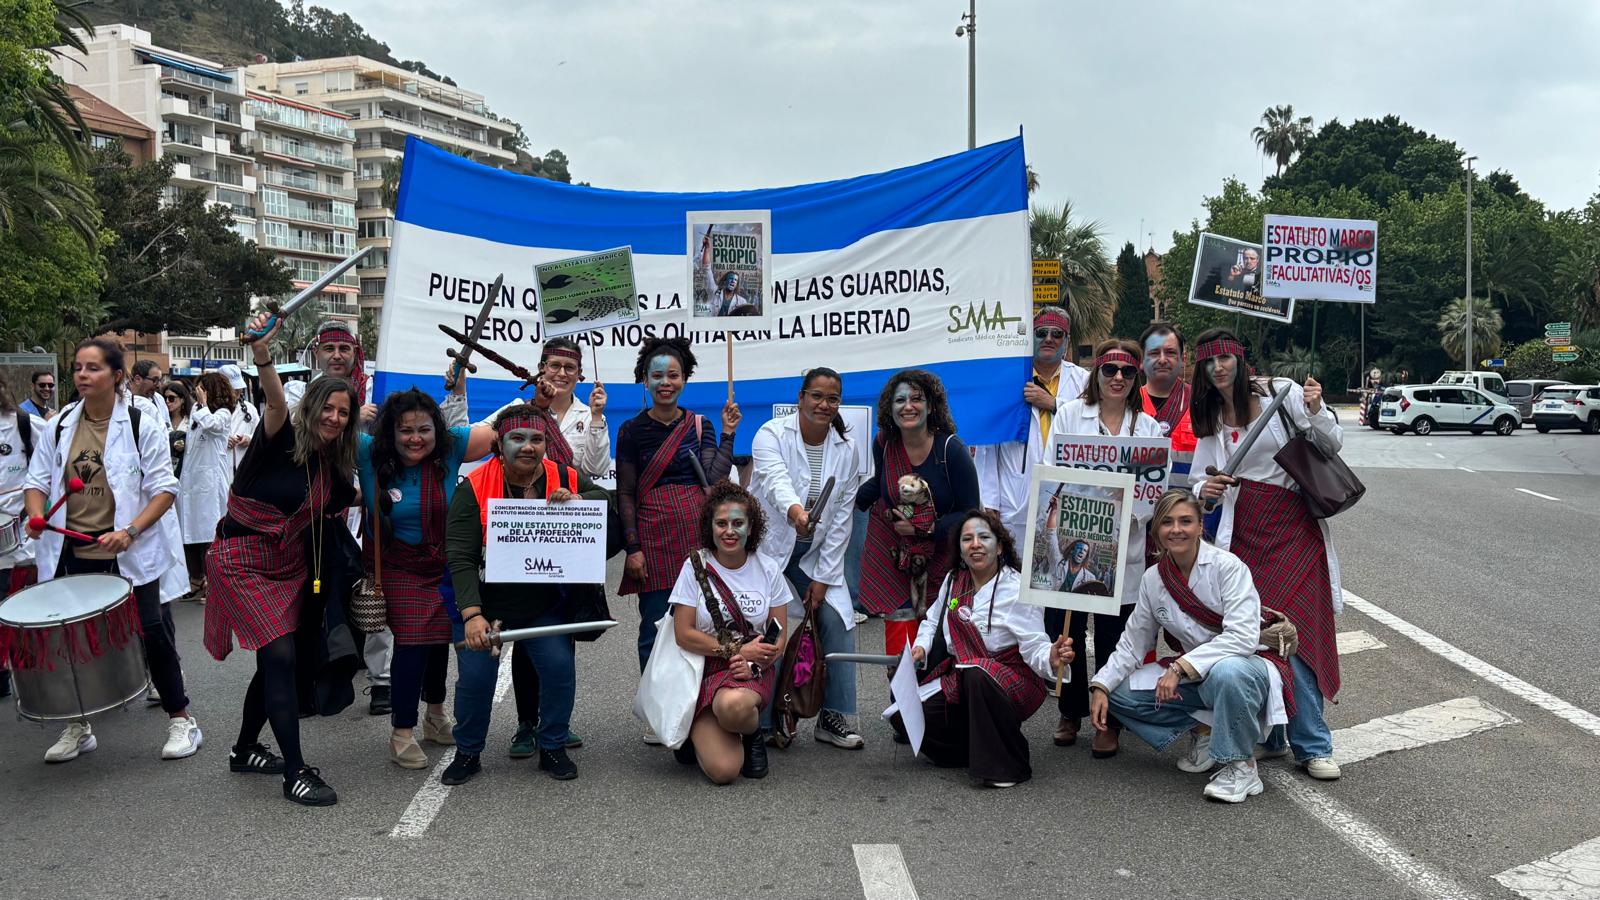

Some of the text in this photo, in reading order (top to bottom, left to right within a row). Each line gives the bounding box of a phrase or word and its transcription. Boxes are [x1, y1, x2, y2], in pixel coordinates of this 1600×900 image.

[712, 233, 757, 249] ESTATUTO
[1267, 225, 1373, 249] ESTATUTO MARCO
[712, 248, 757, 264] PROPIO
[1267, 246, 1374, 267] PROPIO
[1272, 265, 1371, 287] FACULTATIVAS/OS
[794, 275, 834, 302] LAS
[840, 267, 951, 298] GUARDIAS,
[1215, 284, 1244, 299] Estatuto
[948, 299, 1021, 335] SMA
[612, 323, 657, 347] NOS
[778, 315, 806, 340] LA
[811, 307, 910, 338] LIBERTAD
[948, 335, 974, 344] Sindicato
[975, 333, 995, 341] Médico
[997, 339, 1029, 347] Granada
[1056, 443, 1166, 465] ESTATUTO MARCO
[1061, 494, 1115, 517] ESTATUTO
[491, 521, 509, 529] POR
[525, 522, 570, 530] ESTATUTO
[571, 522, 602, 530] PROPIO
[1059, 510, 1114, 535] PROPIO
[497, 534, 596, 544] MÉDICA Y FACULTATIVA
[534, 528, 582, 537] PROFESIÓN
[1058, 527, 1113, 543] PARA LOS MÉDICOS
[525, 557, 559, 571] SMA
